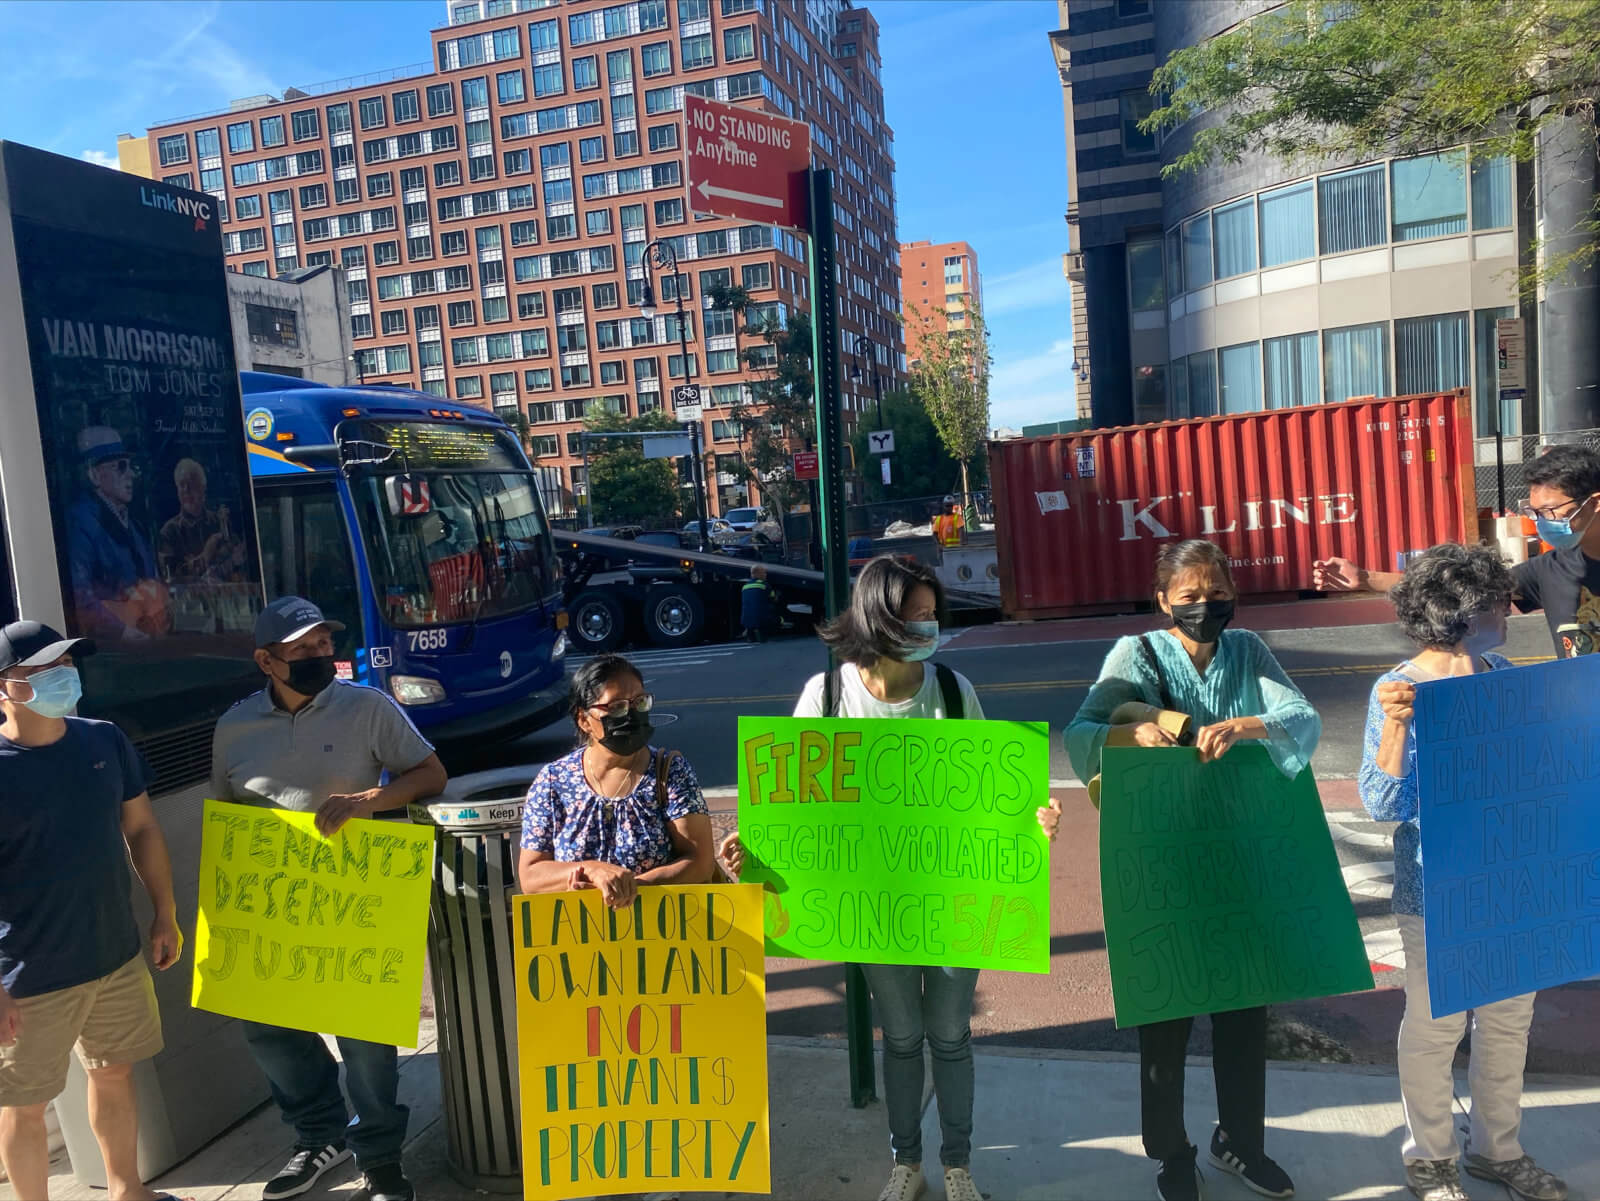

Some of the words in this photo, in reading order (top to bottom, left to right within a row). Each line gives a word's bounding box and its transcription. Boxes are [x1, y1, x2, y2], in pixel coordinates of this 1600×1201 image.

[693, 108, 715, 132] NO
[719, 115, 791, 149] STANDING
[140, 185, 211, 220] LinkNYC
[42, 317, 98, 359] VAN
[103, 324, 218, 369] MORRISON
[103, 363, 151, 395] TOM
[159, 368, 222, 398] JONES
[1199, 492, 1358, 535] LINE
[1224, 553, 1285, 569] ine.com
[407, 627, 448, 652] 7658
[744, 730, 863, 806] FIRE
[489, 808, 515, 820] Keep
[1482, 793, 1569, 866] NOT
[209, 811, 429, 883] TENANTS
[748, 824, 864, 873] RIGHT
[215, 865, 383, 928] DESERVE
[521, 892, 735, 948] LANDLORD
[795, 888, 946, 956] SINCE
[950, 893, 1040, 961] 5/2
[207, 924, 404, 984] JUSTICE
[527, 948, 623, 1003] OWN
[636, 946, 747, 995] LAND
[587, 1003, 696, 1057] NOT
[539, 1118, 757, 1186] PROPERTY
